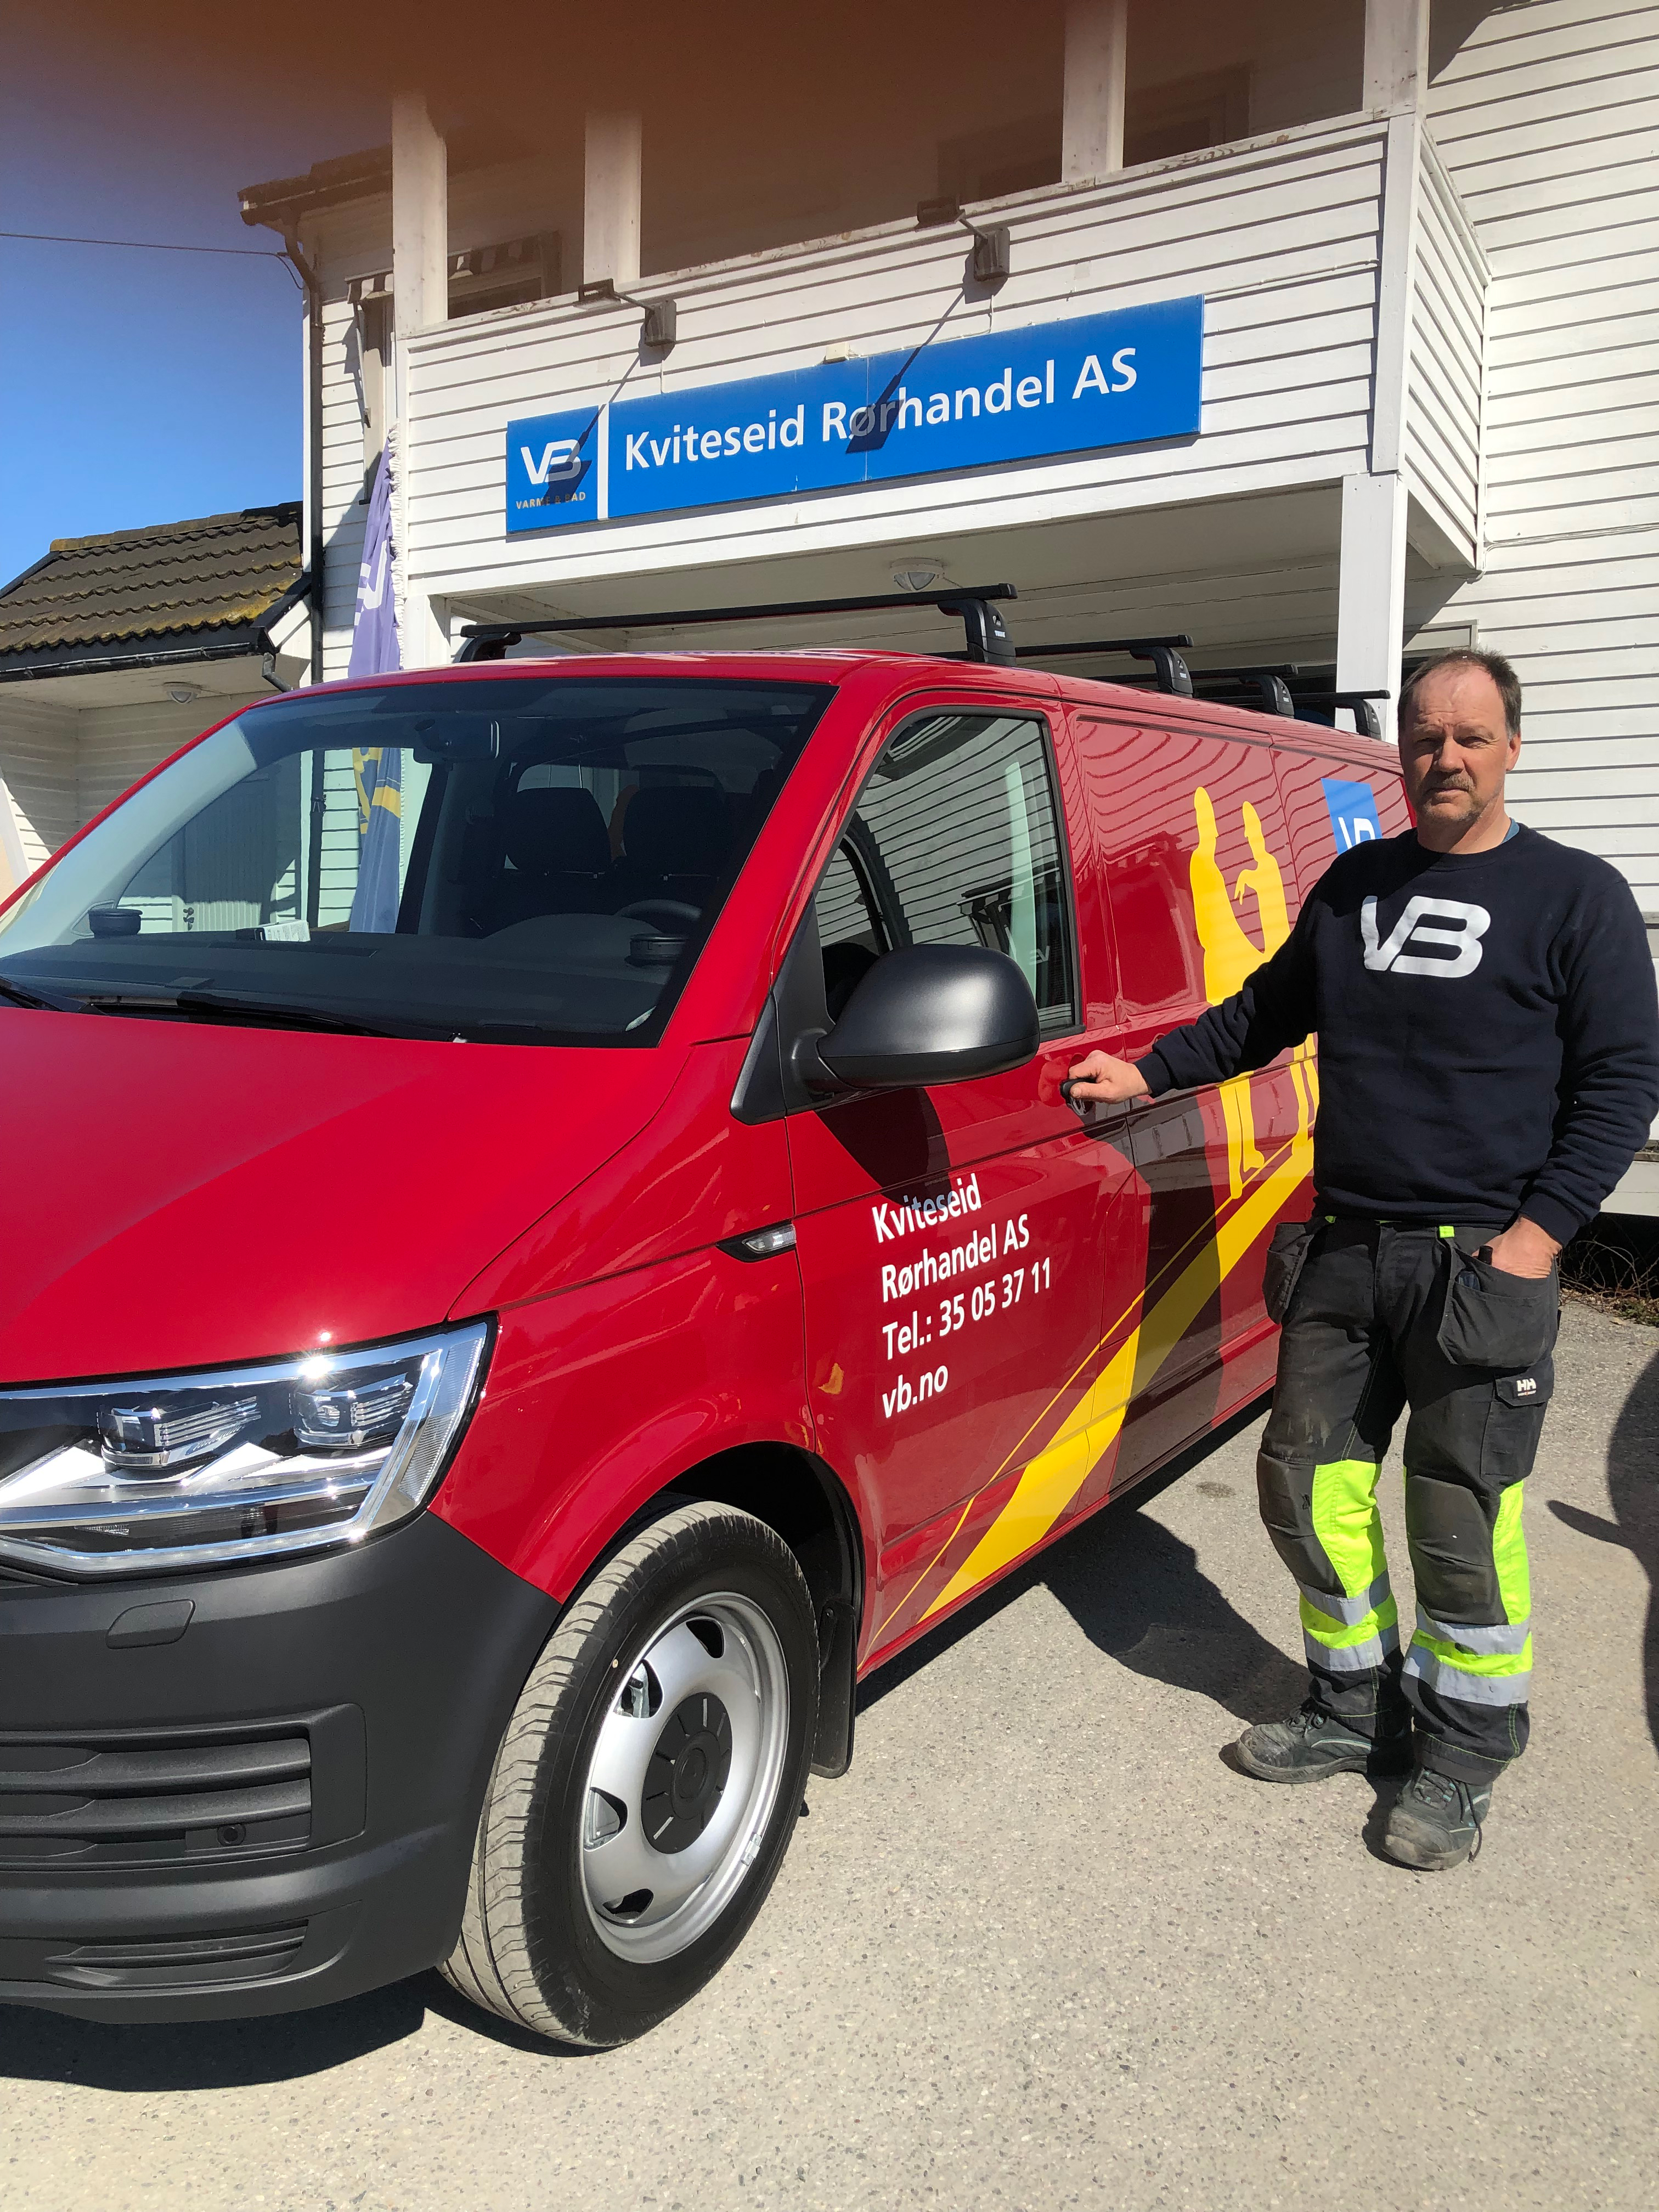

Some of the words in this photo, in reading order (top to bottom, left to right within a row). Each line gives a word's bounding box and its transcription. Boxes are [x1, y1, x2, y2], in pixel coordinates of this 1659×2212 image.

[626, 404, 805, 470] Kviteseid
[823, 359, 1055, 441] Rørhandel
[1072, 348, 1137, 399] AS
[521, 439, 582, 484] VB
[1361, 895, 1491, 978] VB
[871, 1173, 981, 1243] Kviteseid
[882, 1223, 997, 1302] Rørhandel
[1003, 1214, 1030, 1255] AS
[882, 1310, 932, 1360] Tel.:
[939, 1294, 964, 1336] 35
[971, 1280, 996, 1321] 05
[1002, 1268, 1024, 1308] 37
[1031, 1257, 1050, 1294] 11
[882, 1365, 948, 1419] vb.no
[1516, 1378, 1537, 1391] HH
